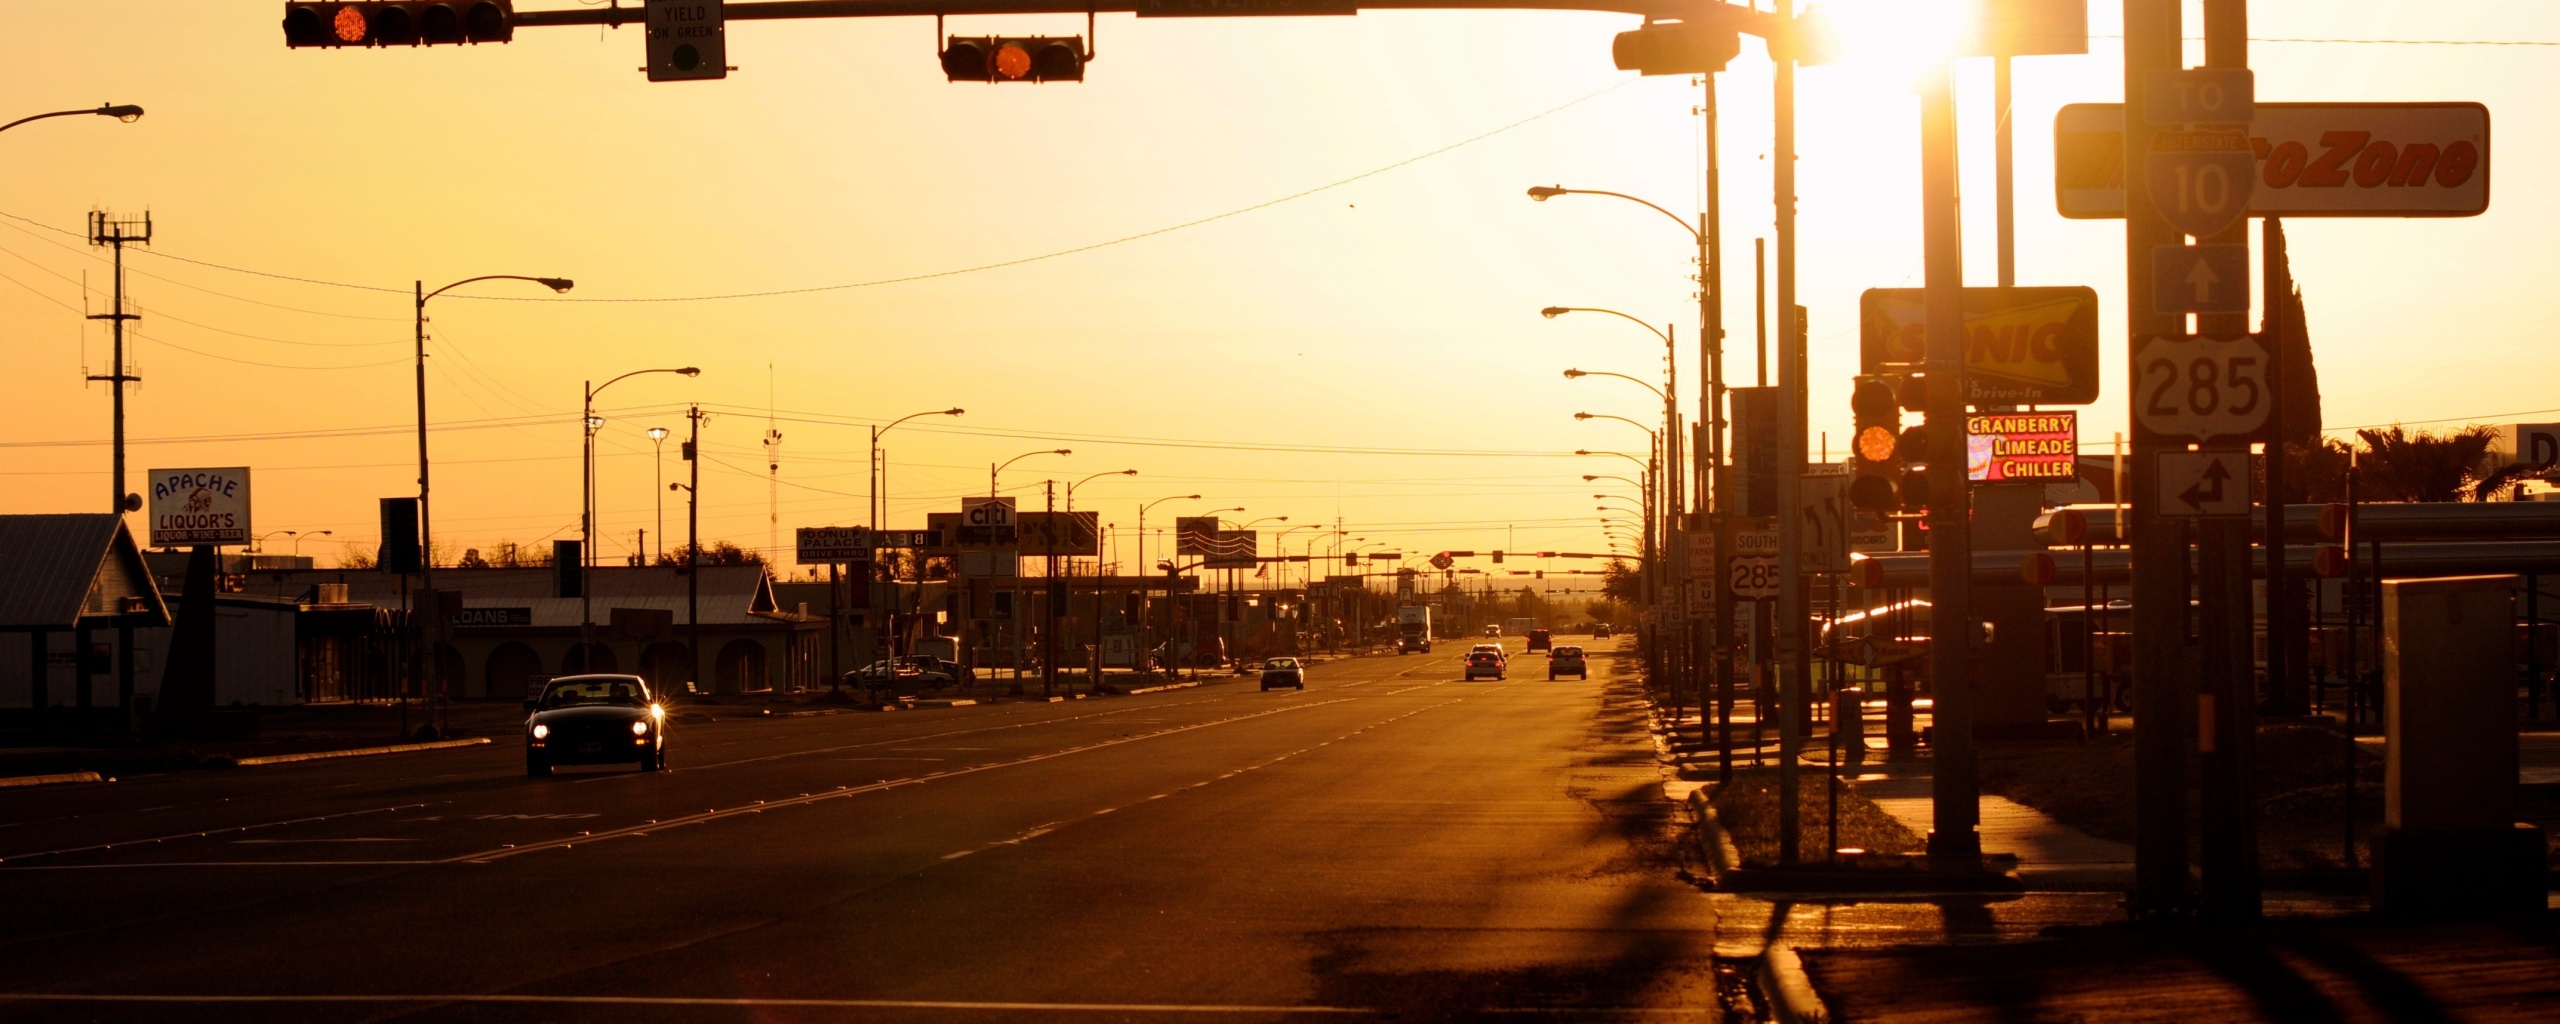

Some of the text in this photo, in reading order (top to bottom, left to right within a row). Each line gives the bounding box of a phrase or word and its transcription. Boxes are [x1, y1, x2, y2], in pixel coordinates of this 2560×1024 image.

[664, 6, 705, 22] YIELD
[654, 26, 713, 39] ON GREEN
[2172, 81, 2223, 112] TO
[2162, 135, 2239, 150] INTERSTATE
[2249, 130, 2479, 190] toZone
[2175, 164, 2229, 213] 10
[1898, 321, 2067, 365] SNIC
[1970, 387, 2043, 400] Drive-In
[2146, 357, 2259, 416] 285
[1967, 417, 2071, 434] CRANBERRY
[1994, 439, 2073, 456] LIMEADE
[2002, 460, 2074, 478] CHILLER
[155, 473, 238, 500] APACHE
[160, 513, 234, 529] LIQUOR'S
[970, 508, 1006, 525] citi
[155, 530, 242, 541] LIQUOR WINE BEER
[806, 529, 862, 539] DONUT
[1698, 536, 1711, 545] NO
[804, 538, 863, 548] PALACE
[1737, 535, 1777, 549] SOUTH
[802, 549, 865, 559] DRIVE THRU
[1690, 548, 1715, 556] PARKIN
[1802, 551, 1828, 566] ONLY
[1733, 564, 1779, 589] 285
[1701, 590, 1711, 600] U
[451, 609, 508, 624] LOANS
